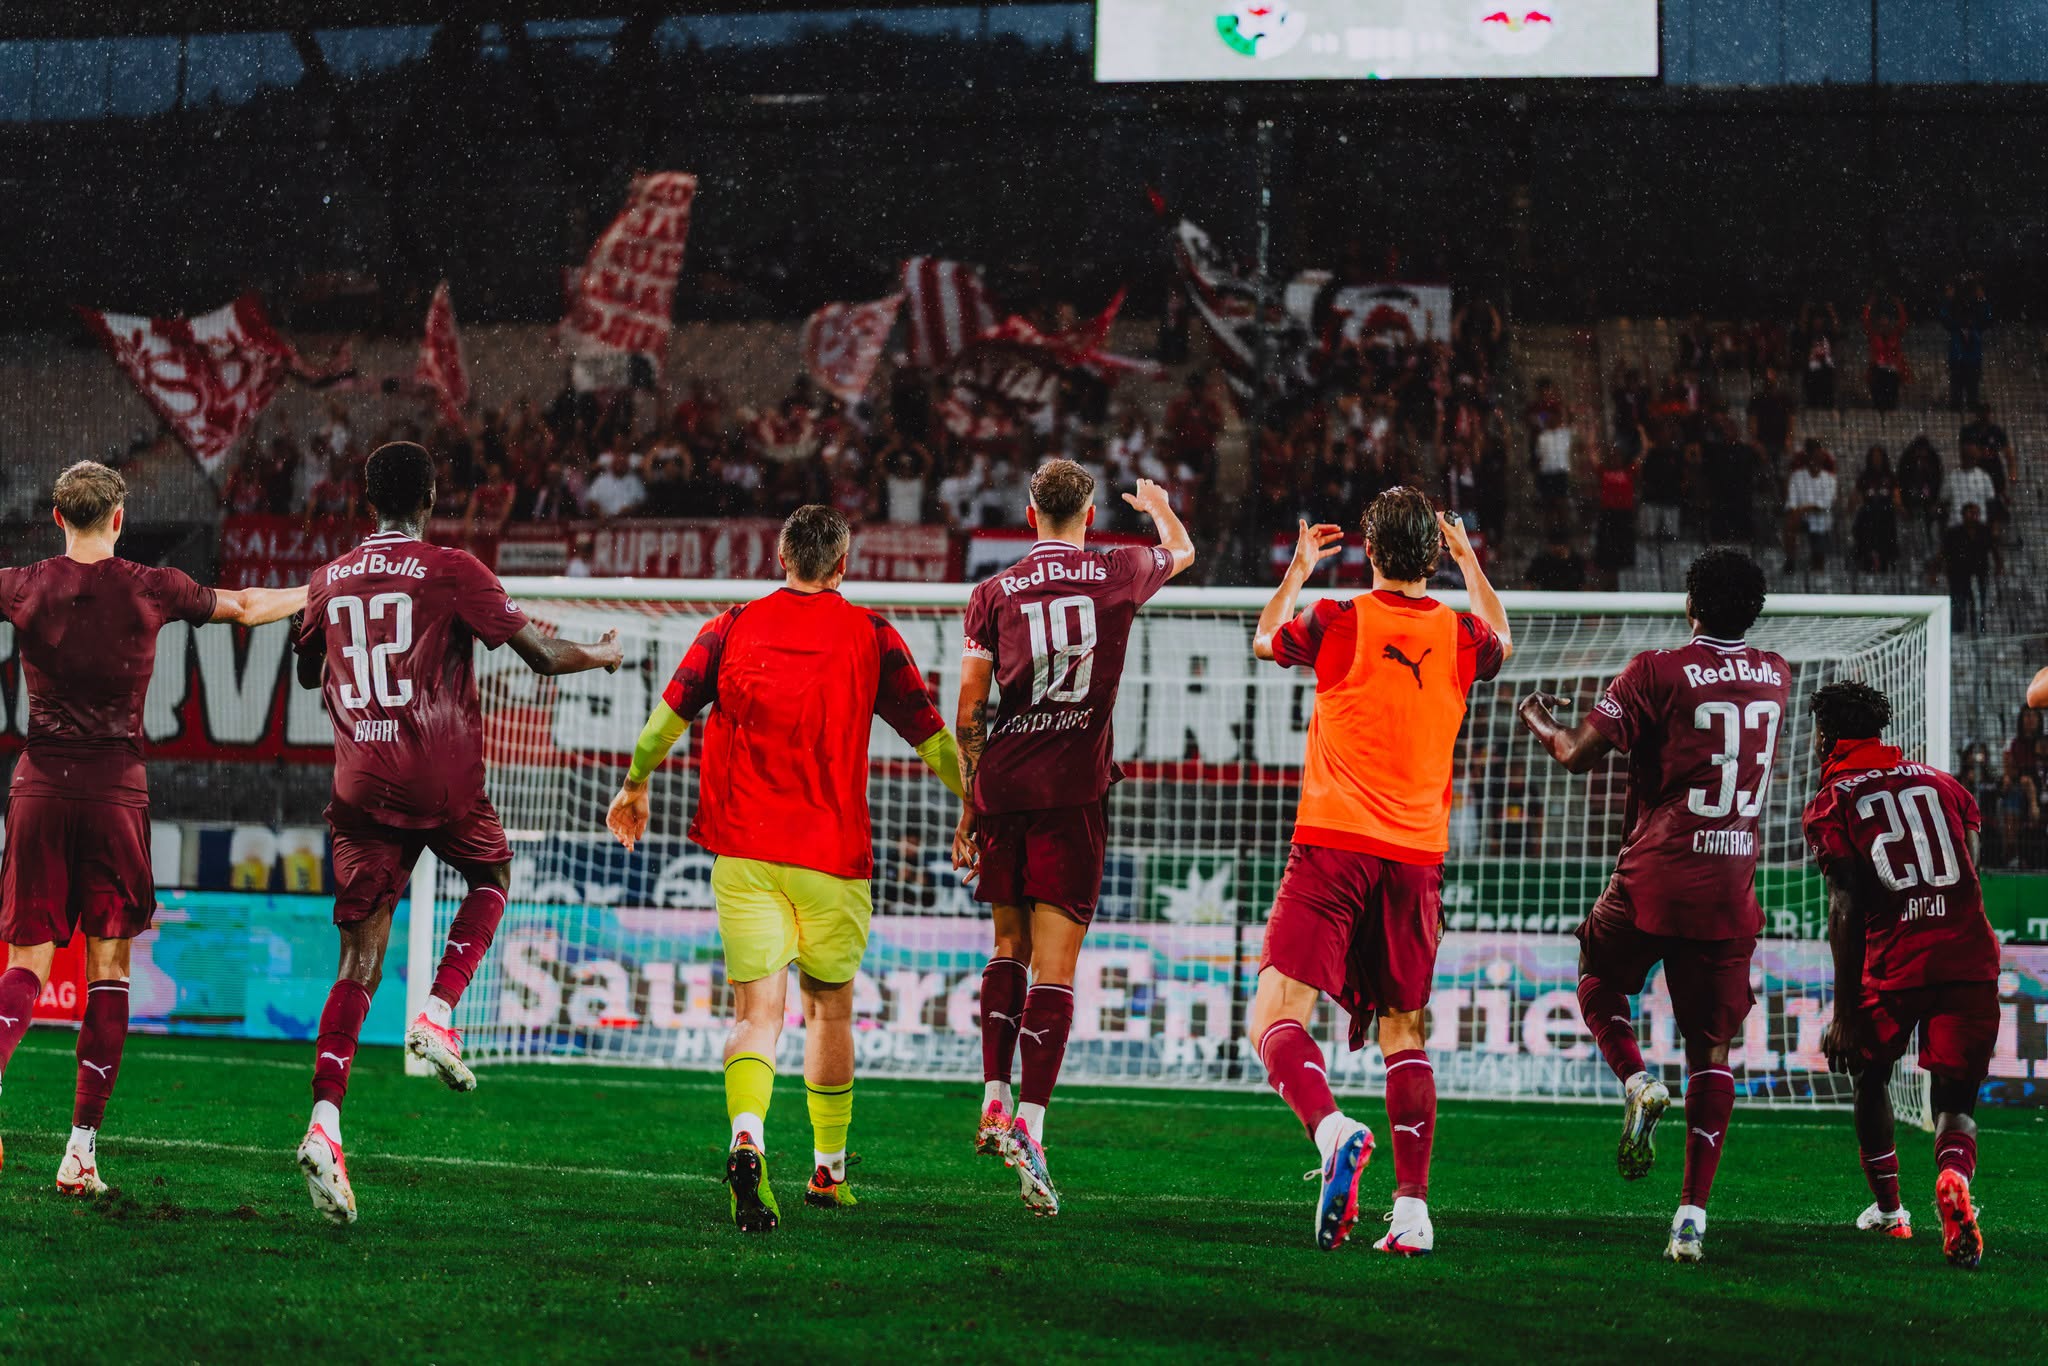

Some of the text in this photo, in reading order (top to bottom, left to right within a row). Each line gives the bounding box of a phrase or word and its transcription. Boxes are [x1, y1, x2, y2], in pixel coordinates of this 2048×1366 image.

[326, 553, 367, 586] Red
[368, 553, 428, 579] Bulls
[1000, 561, 1108, 597] Red Bulls
[327, 592, 413, 709] 32
[1020, 595, 1098, 706] 18
[1682, 658, 1782, 689] Red Bulls
[1687, 700, 1781, 818] 33
[1856, 785, 1960, 891] 20
